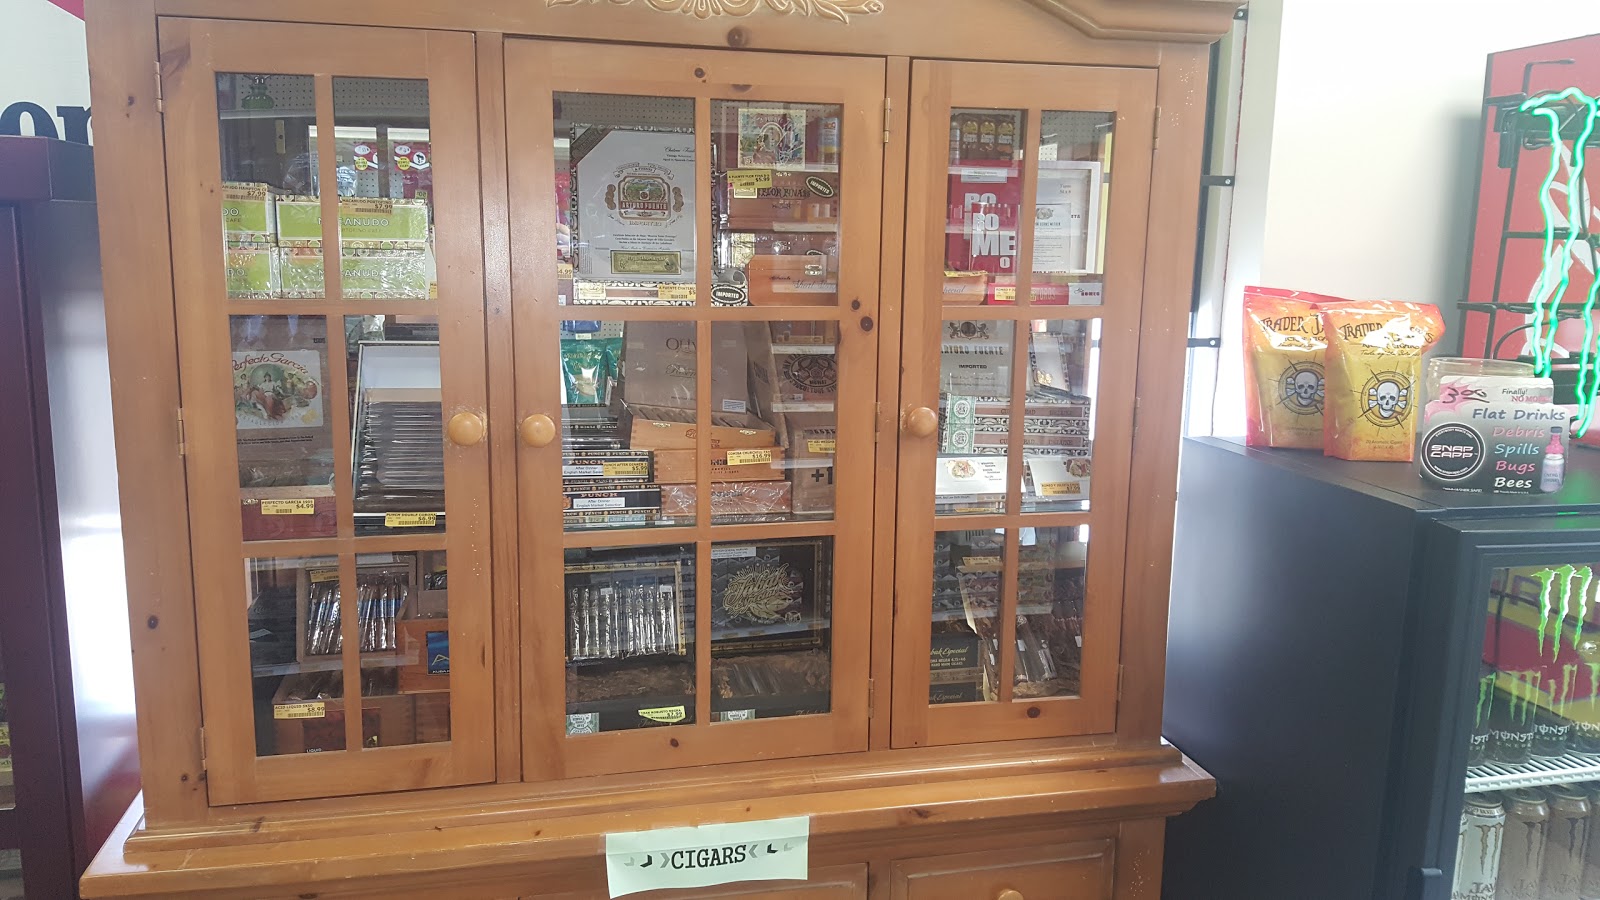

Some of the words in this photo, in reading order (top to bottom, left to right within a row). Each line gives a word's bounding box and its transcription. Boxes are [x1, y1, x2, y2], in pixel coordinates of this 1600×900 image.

[715, 291, 740, 299] IMPORTED
[1501, 388, 1528, 396] Finally!
[1472, 407, 1507, 420] Flat
[1513, 409, 1566, 420] Drinks
[1493, 426, 1546, 438] Debris
[1431, 444, 1474, 452] SNAP
[1494, 443, 1540, 458] Spills
[1430, 451, 1473, 459] CAPP
[1495, 460, 1536, 475] Bugs
[1494, 476, 1533, 489] Bees
[670, 844, 748, 870] CIGARS
